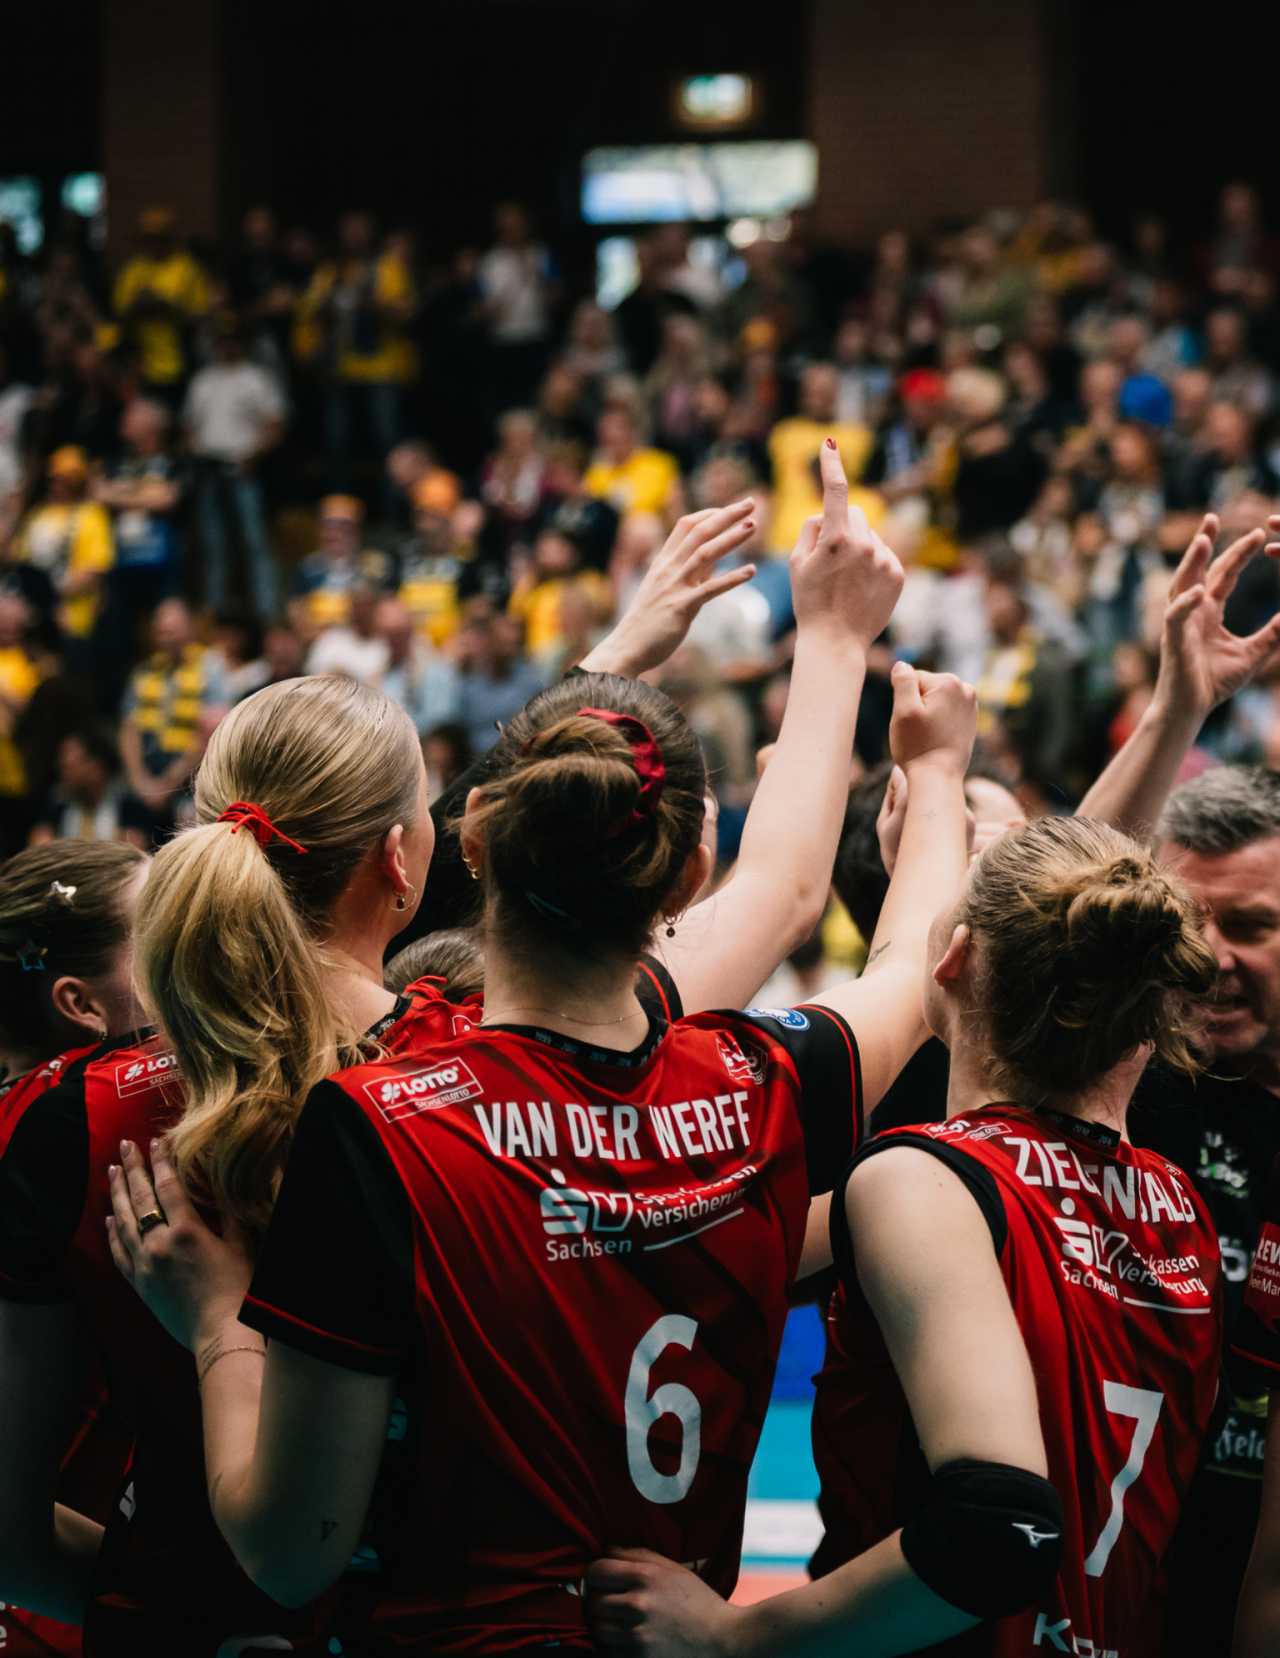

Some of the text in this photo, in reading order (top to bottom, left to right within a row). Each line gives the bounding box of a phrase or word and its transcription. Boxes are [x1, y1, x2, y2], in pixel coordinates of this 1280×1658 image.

[147, 1054, 177, 1072] LOT
[400, 1067, 459, 1095] LOTTO
[473, 1091, 751, 1160] VAN DER WERFF
[546, 1237, 632, 1261] Sachsen
[624, 1313, 702, 1504] 6
[1084, 1379, 1164, 1578] 7
